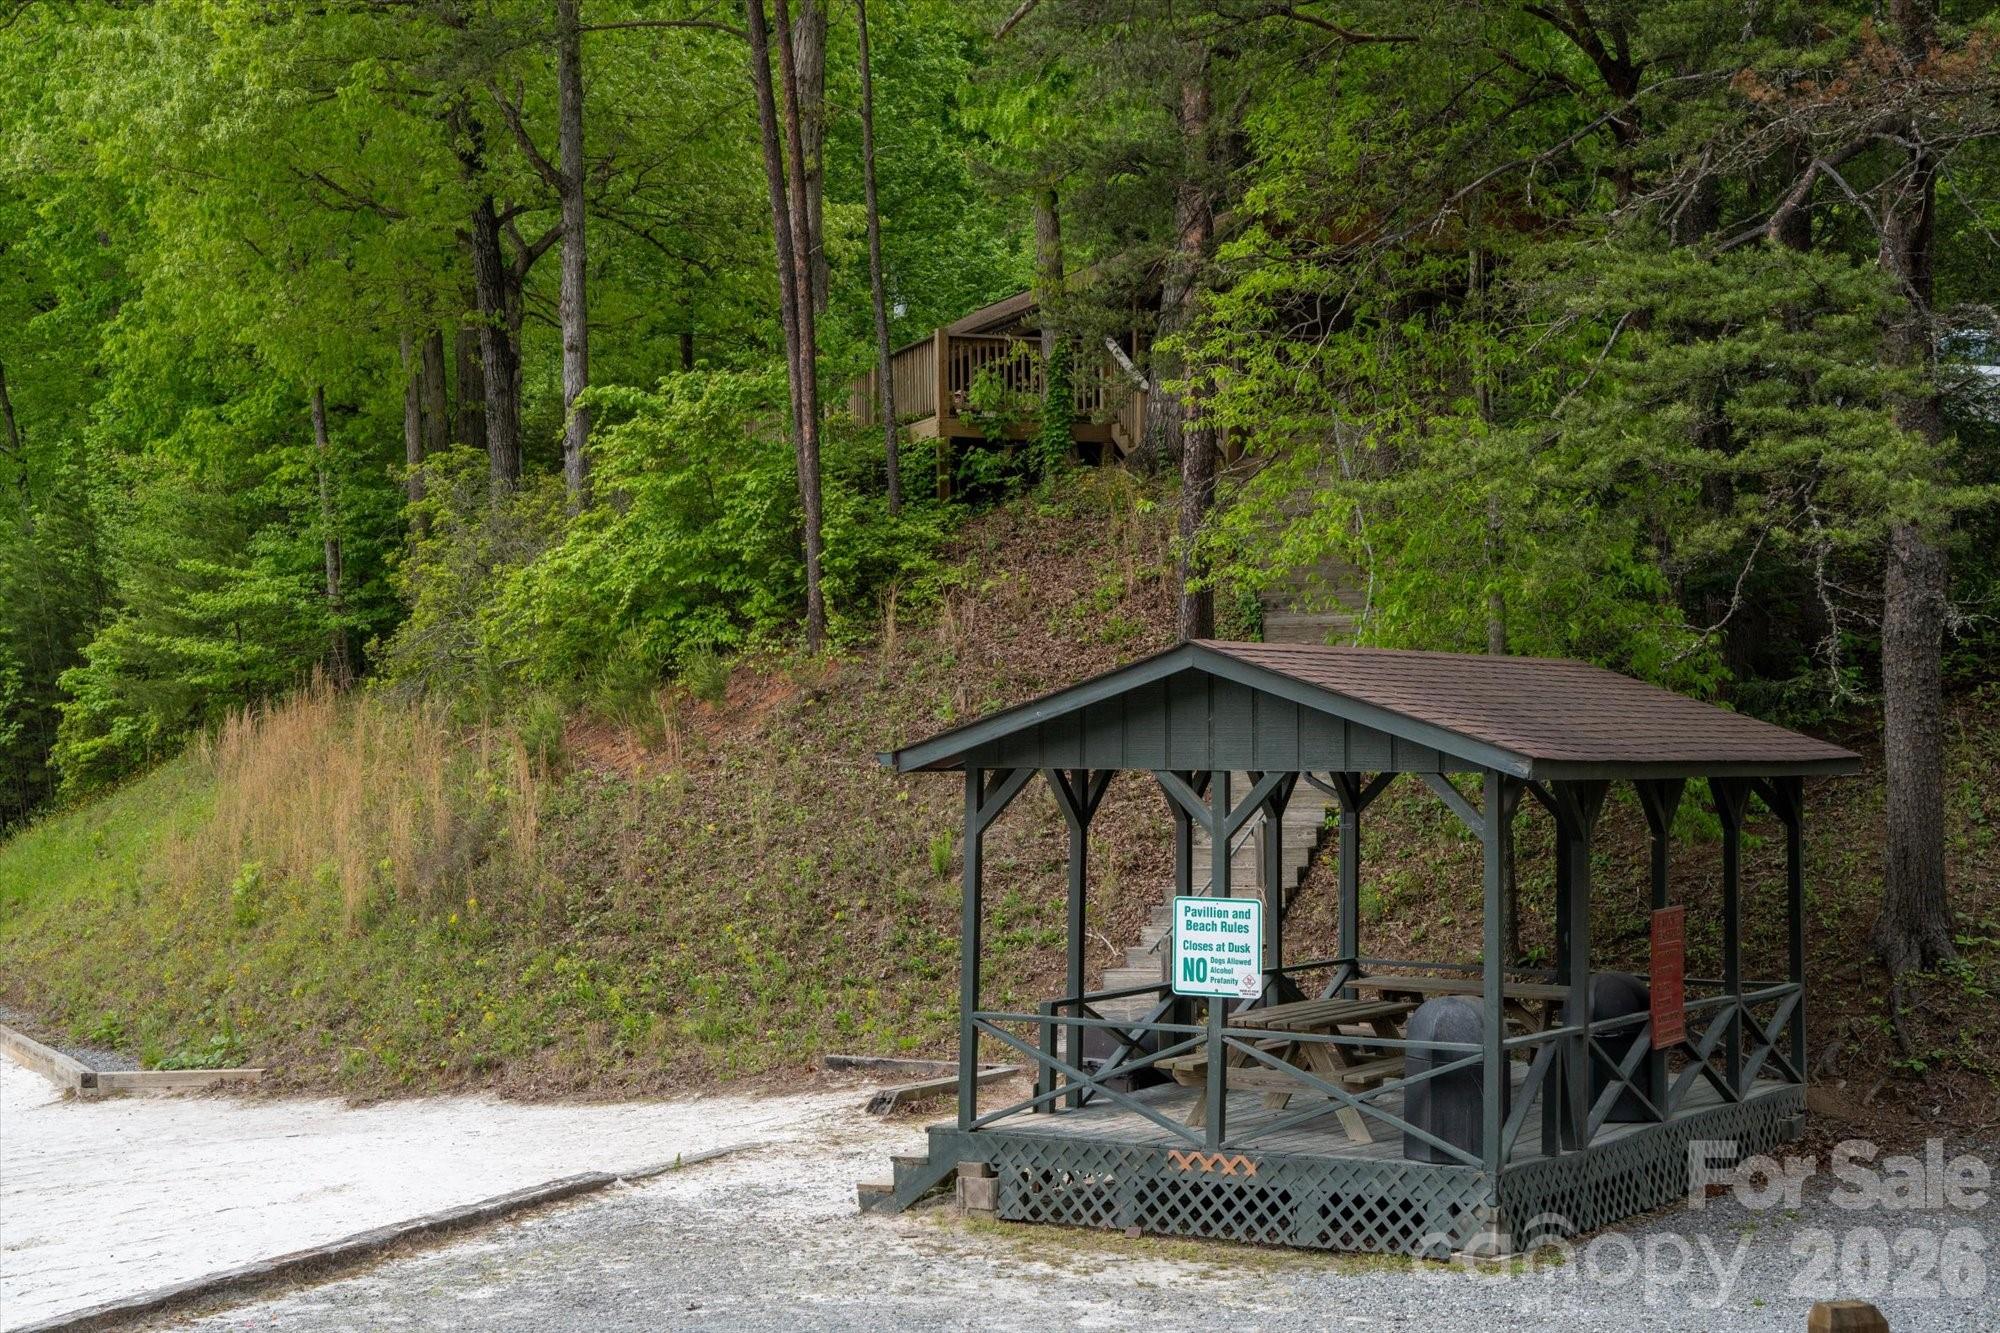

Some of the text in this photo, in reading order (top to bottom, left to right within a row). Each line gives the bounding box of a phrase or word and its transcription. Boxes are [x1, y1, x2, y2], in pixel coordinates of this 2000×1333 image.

[1184, 905, 1251, 919] Pavillion and
[1186, 920, 1249, 933] Beach Rules
[1183, 940, 1250, 953] Closes at Dusk
[1210, 957, 1251, 966] Dogs Allowed
[1183, 957, 1208, 983] NO
[1210, 977, 1238, 986] Profanity
